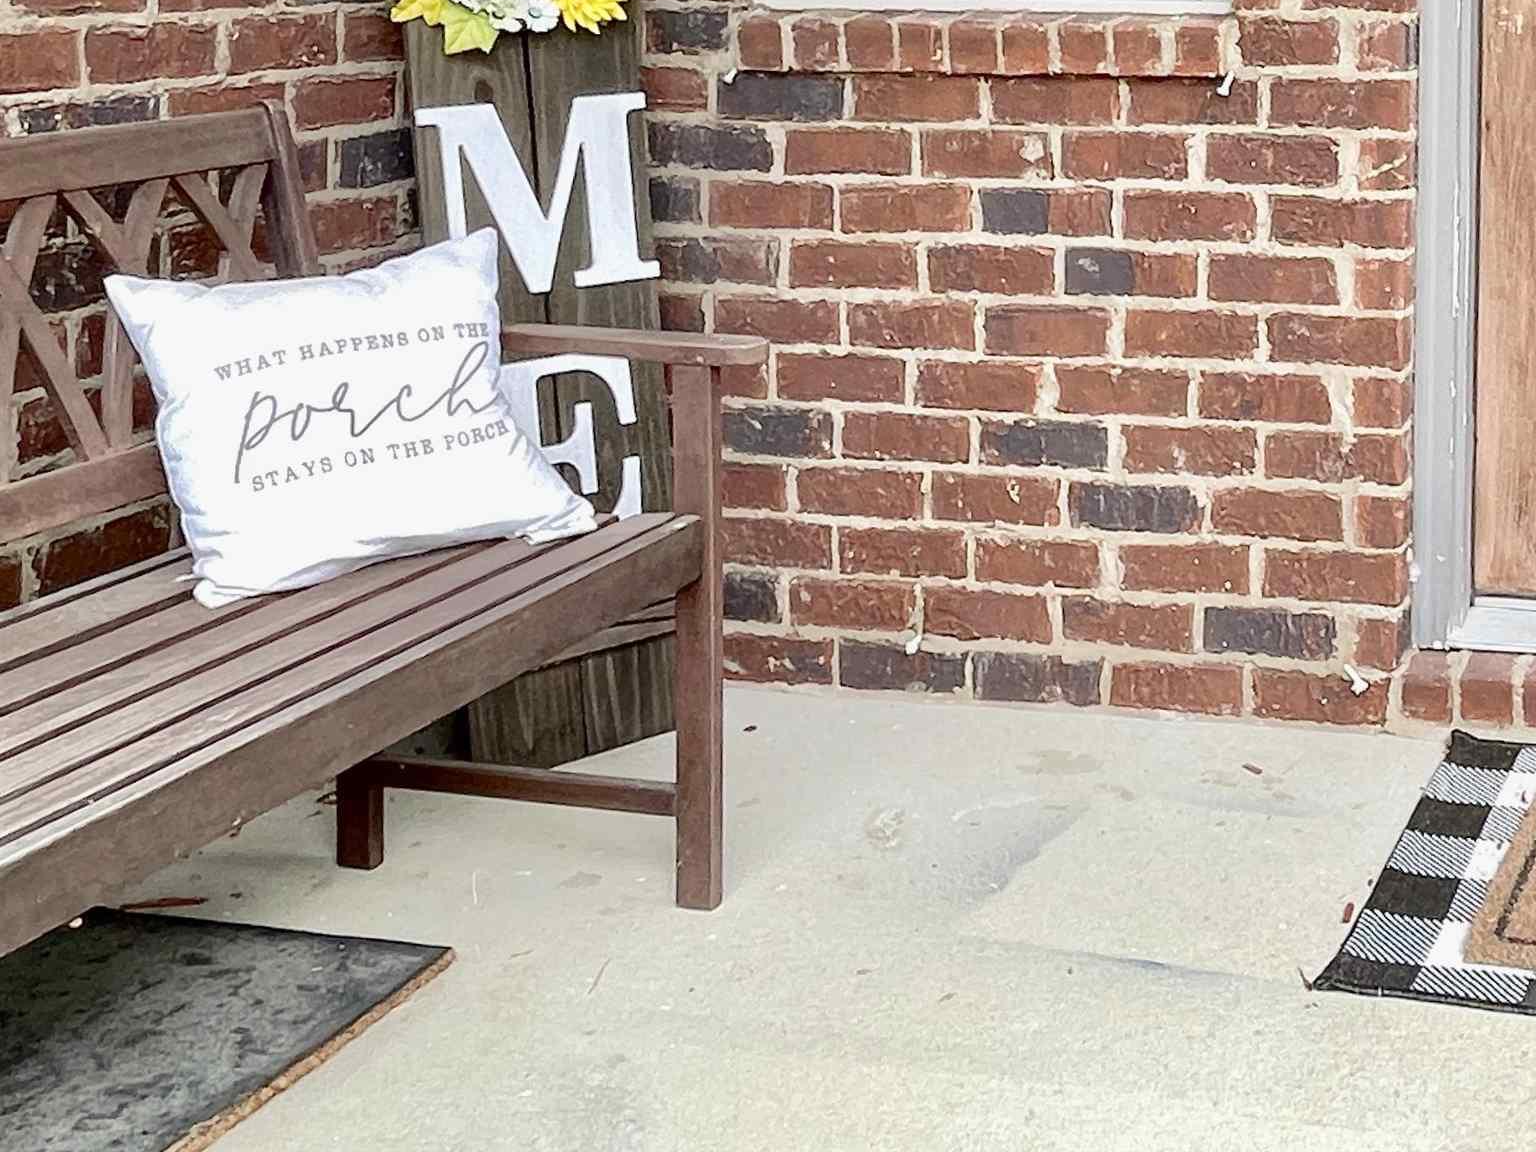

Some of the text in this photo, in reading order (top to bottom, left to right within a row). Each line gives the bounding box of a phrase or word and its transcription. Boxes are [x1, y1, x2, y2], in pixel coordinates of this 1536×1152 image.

[213, 322, 489, 382] WHAT HAPPENS ON THE
[234, 342, 500, 484] porch
[251, 418, 510, 492] STAYS ON THE PORCH
